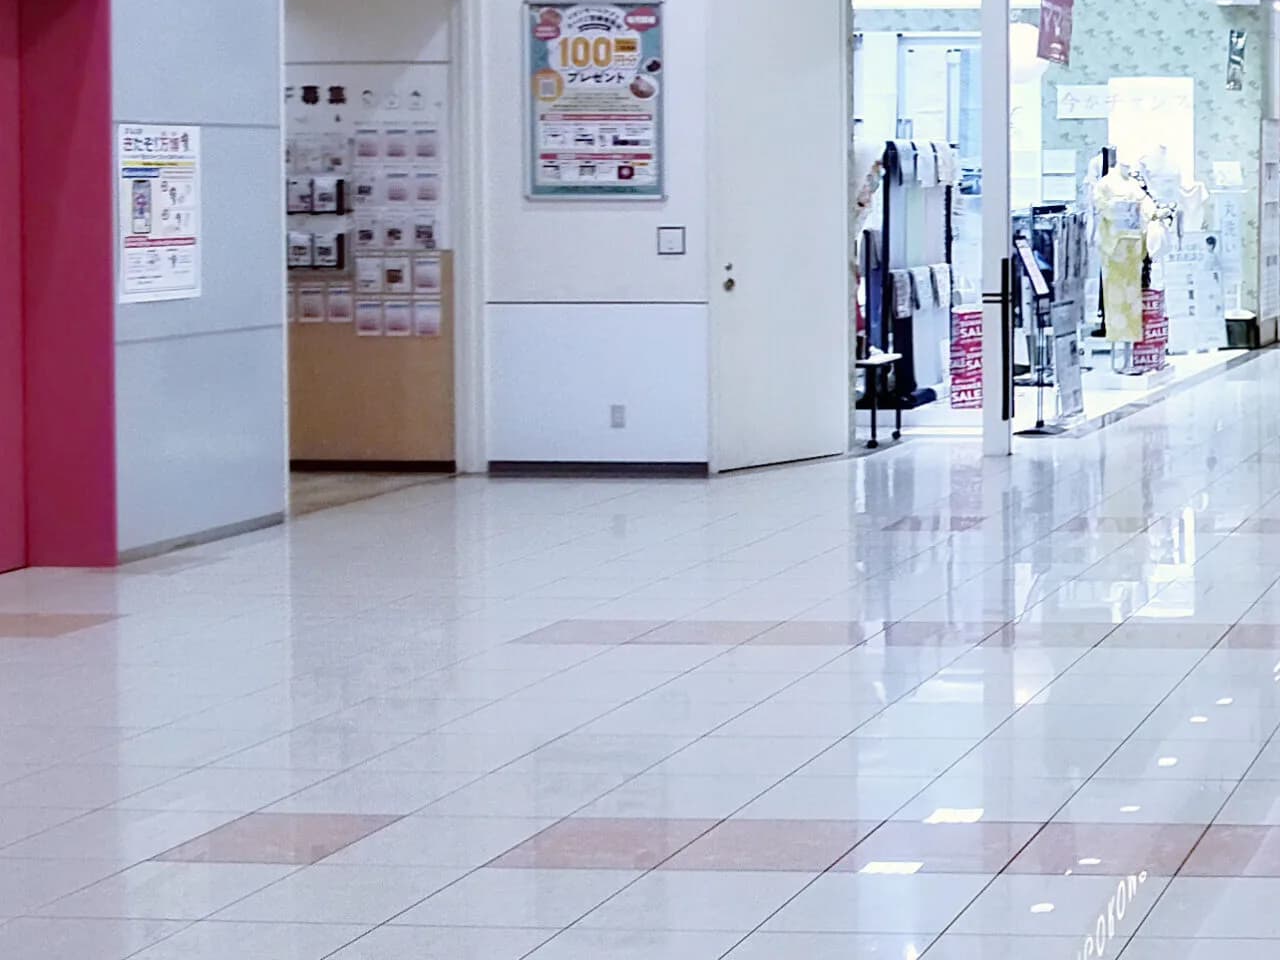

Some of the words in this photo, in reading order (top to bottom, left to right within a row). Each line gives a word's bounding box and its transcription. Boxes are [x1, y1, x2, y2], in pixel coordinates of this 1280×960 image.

[559, 36, 613, 68] 100
[1145, 327, 1169, 339] SALE
[1134, 353, 1160, 365] SALE
[951, 390, 982, 402] SALE
